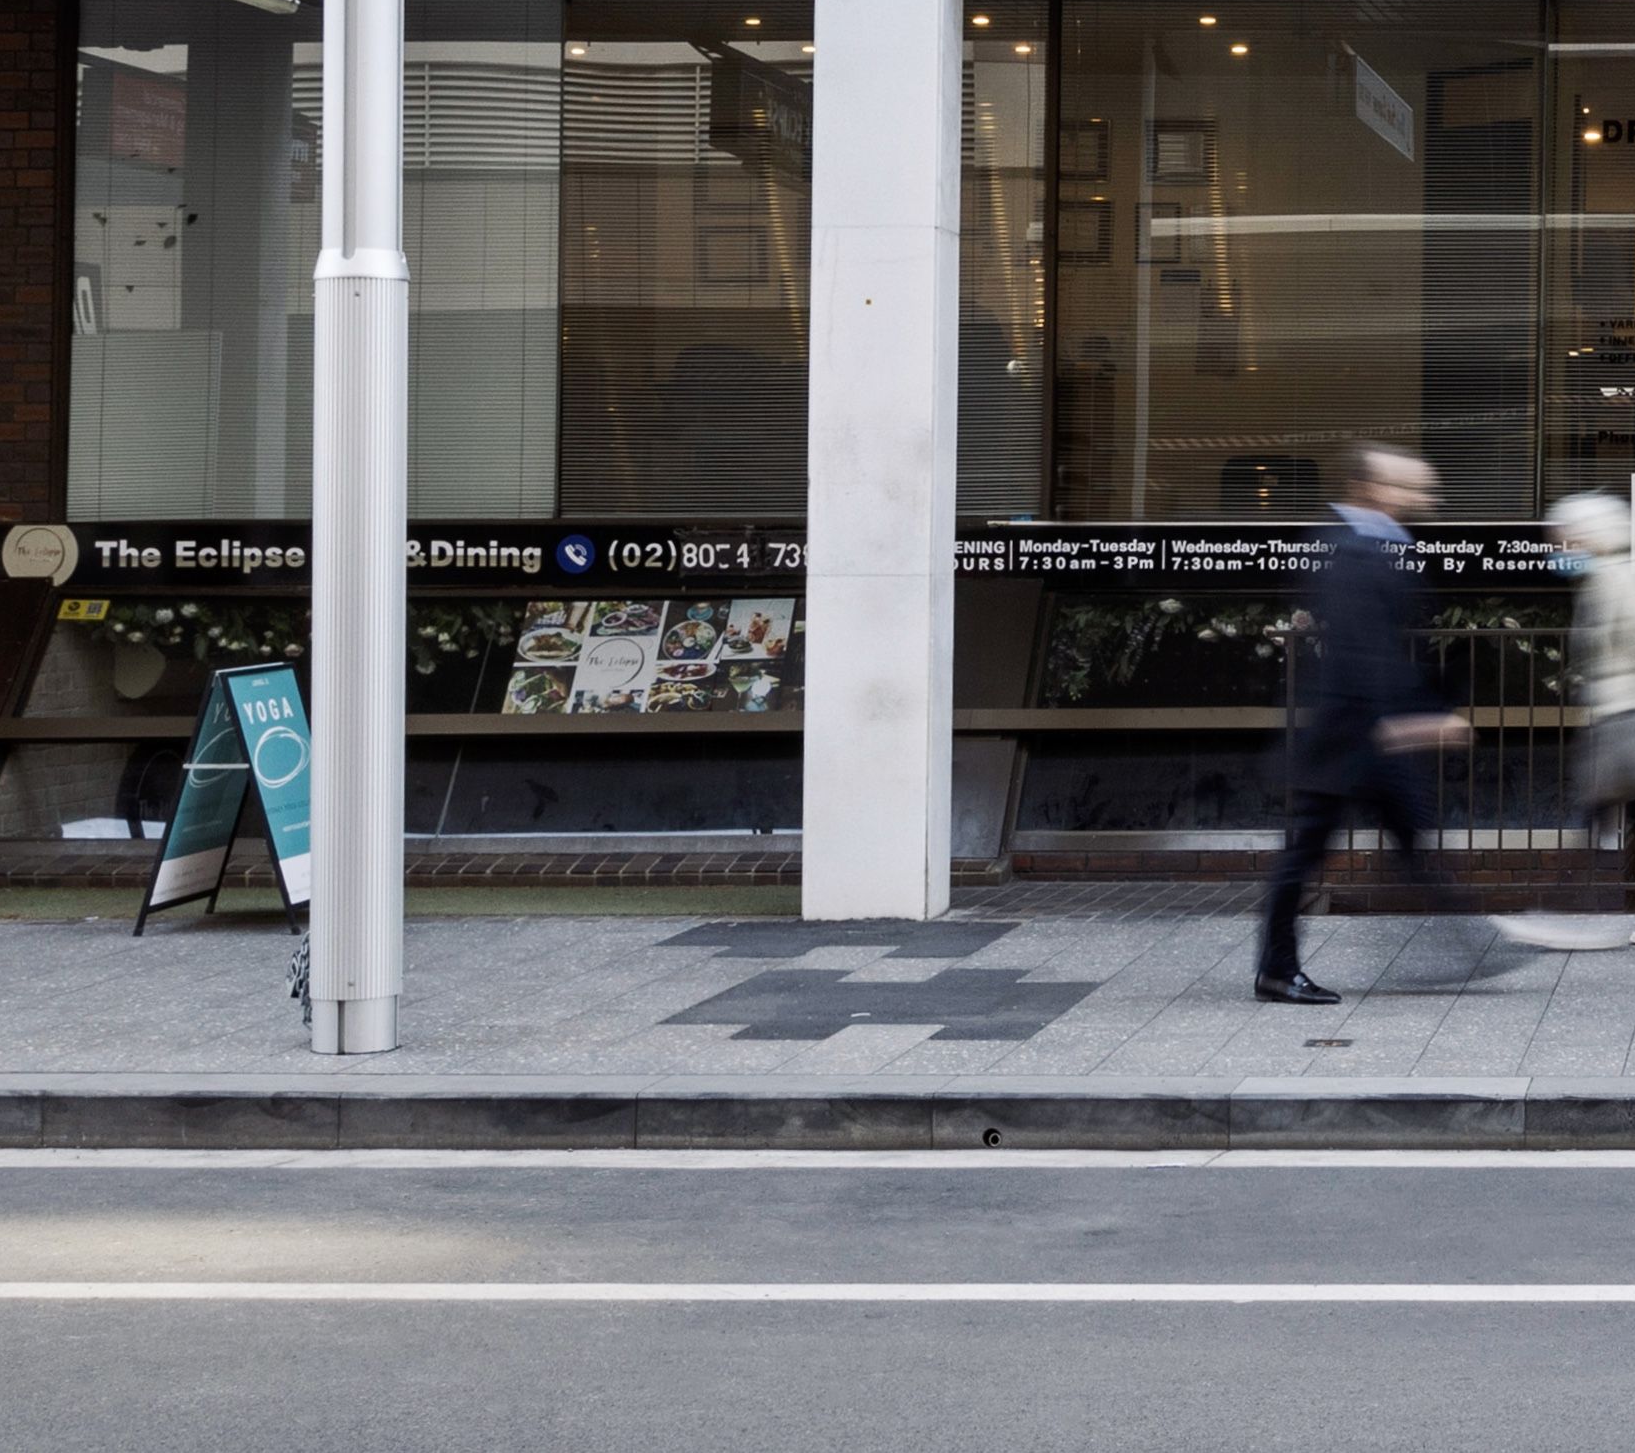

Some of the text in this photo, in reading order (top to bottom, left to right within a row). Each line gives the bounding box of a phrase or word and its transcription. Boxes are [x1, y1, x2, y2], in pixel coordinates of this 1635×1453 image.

[94, 539, 162, 569] The
[175, 539, 306, 574] Eclipse
[1018, 539, 1156, 557] Monday-Tuesday
[1443, 556, 1466, 572] By
[242, 696, 295, 725] YOGA
